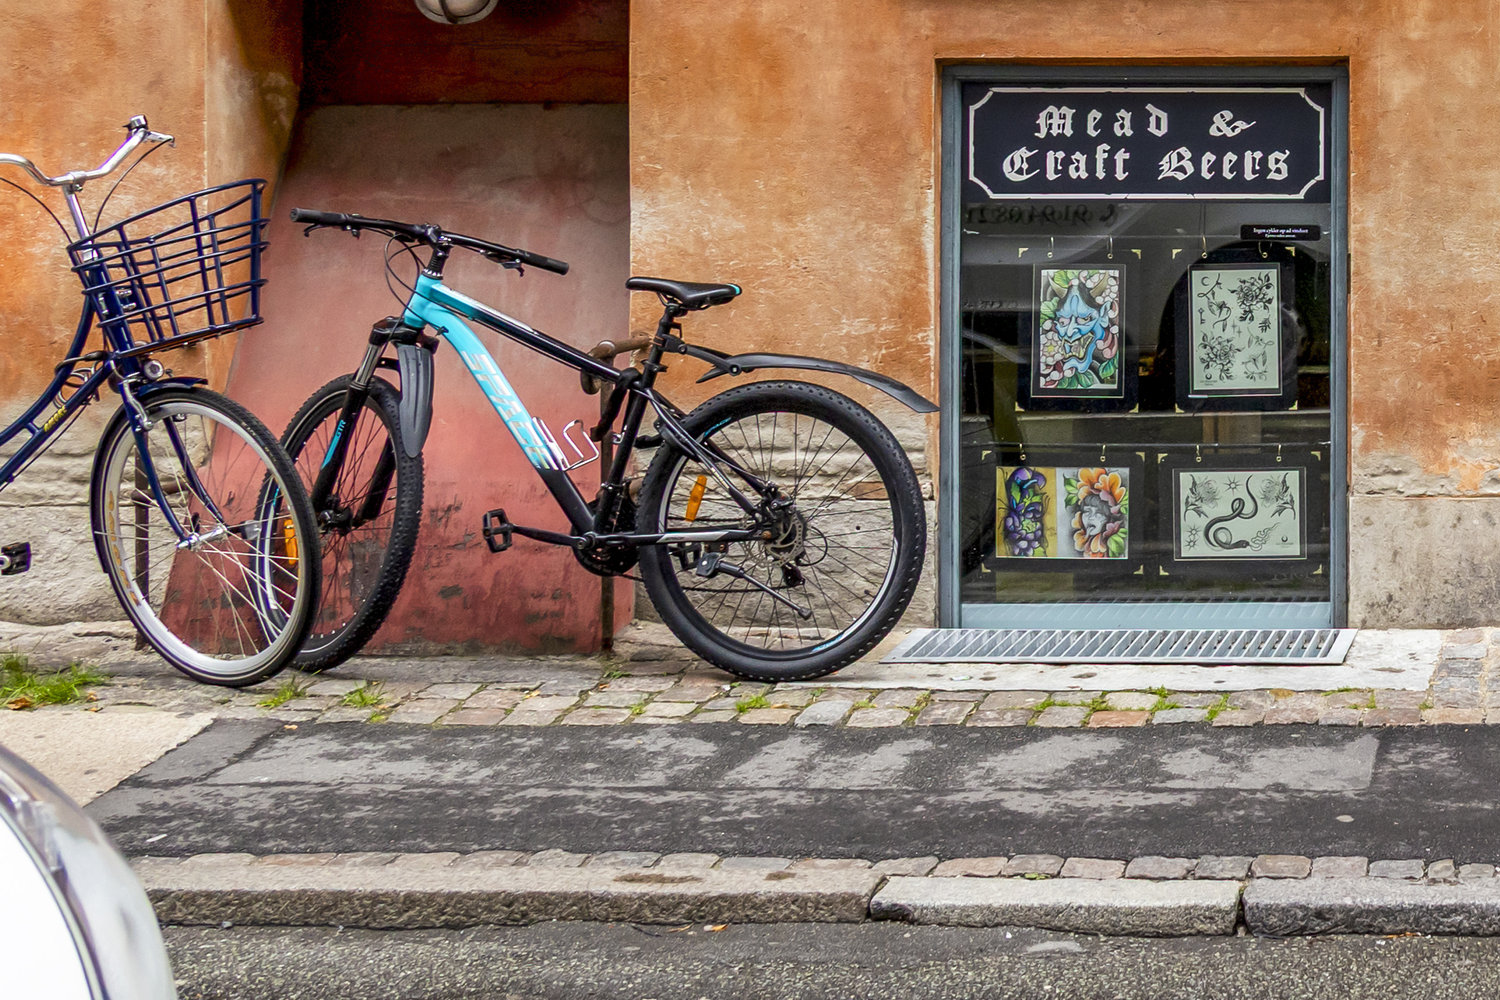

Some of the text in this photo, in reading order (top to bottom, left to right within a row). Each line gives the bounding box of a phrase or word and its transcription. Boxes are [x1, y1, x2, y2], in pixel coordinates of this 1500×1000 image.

[1034, 103, 1256, 138] Mead &
[1001, 142, 1291, 182] Craft Beers
[461, 350, 560, 471] SPACE
